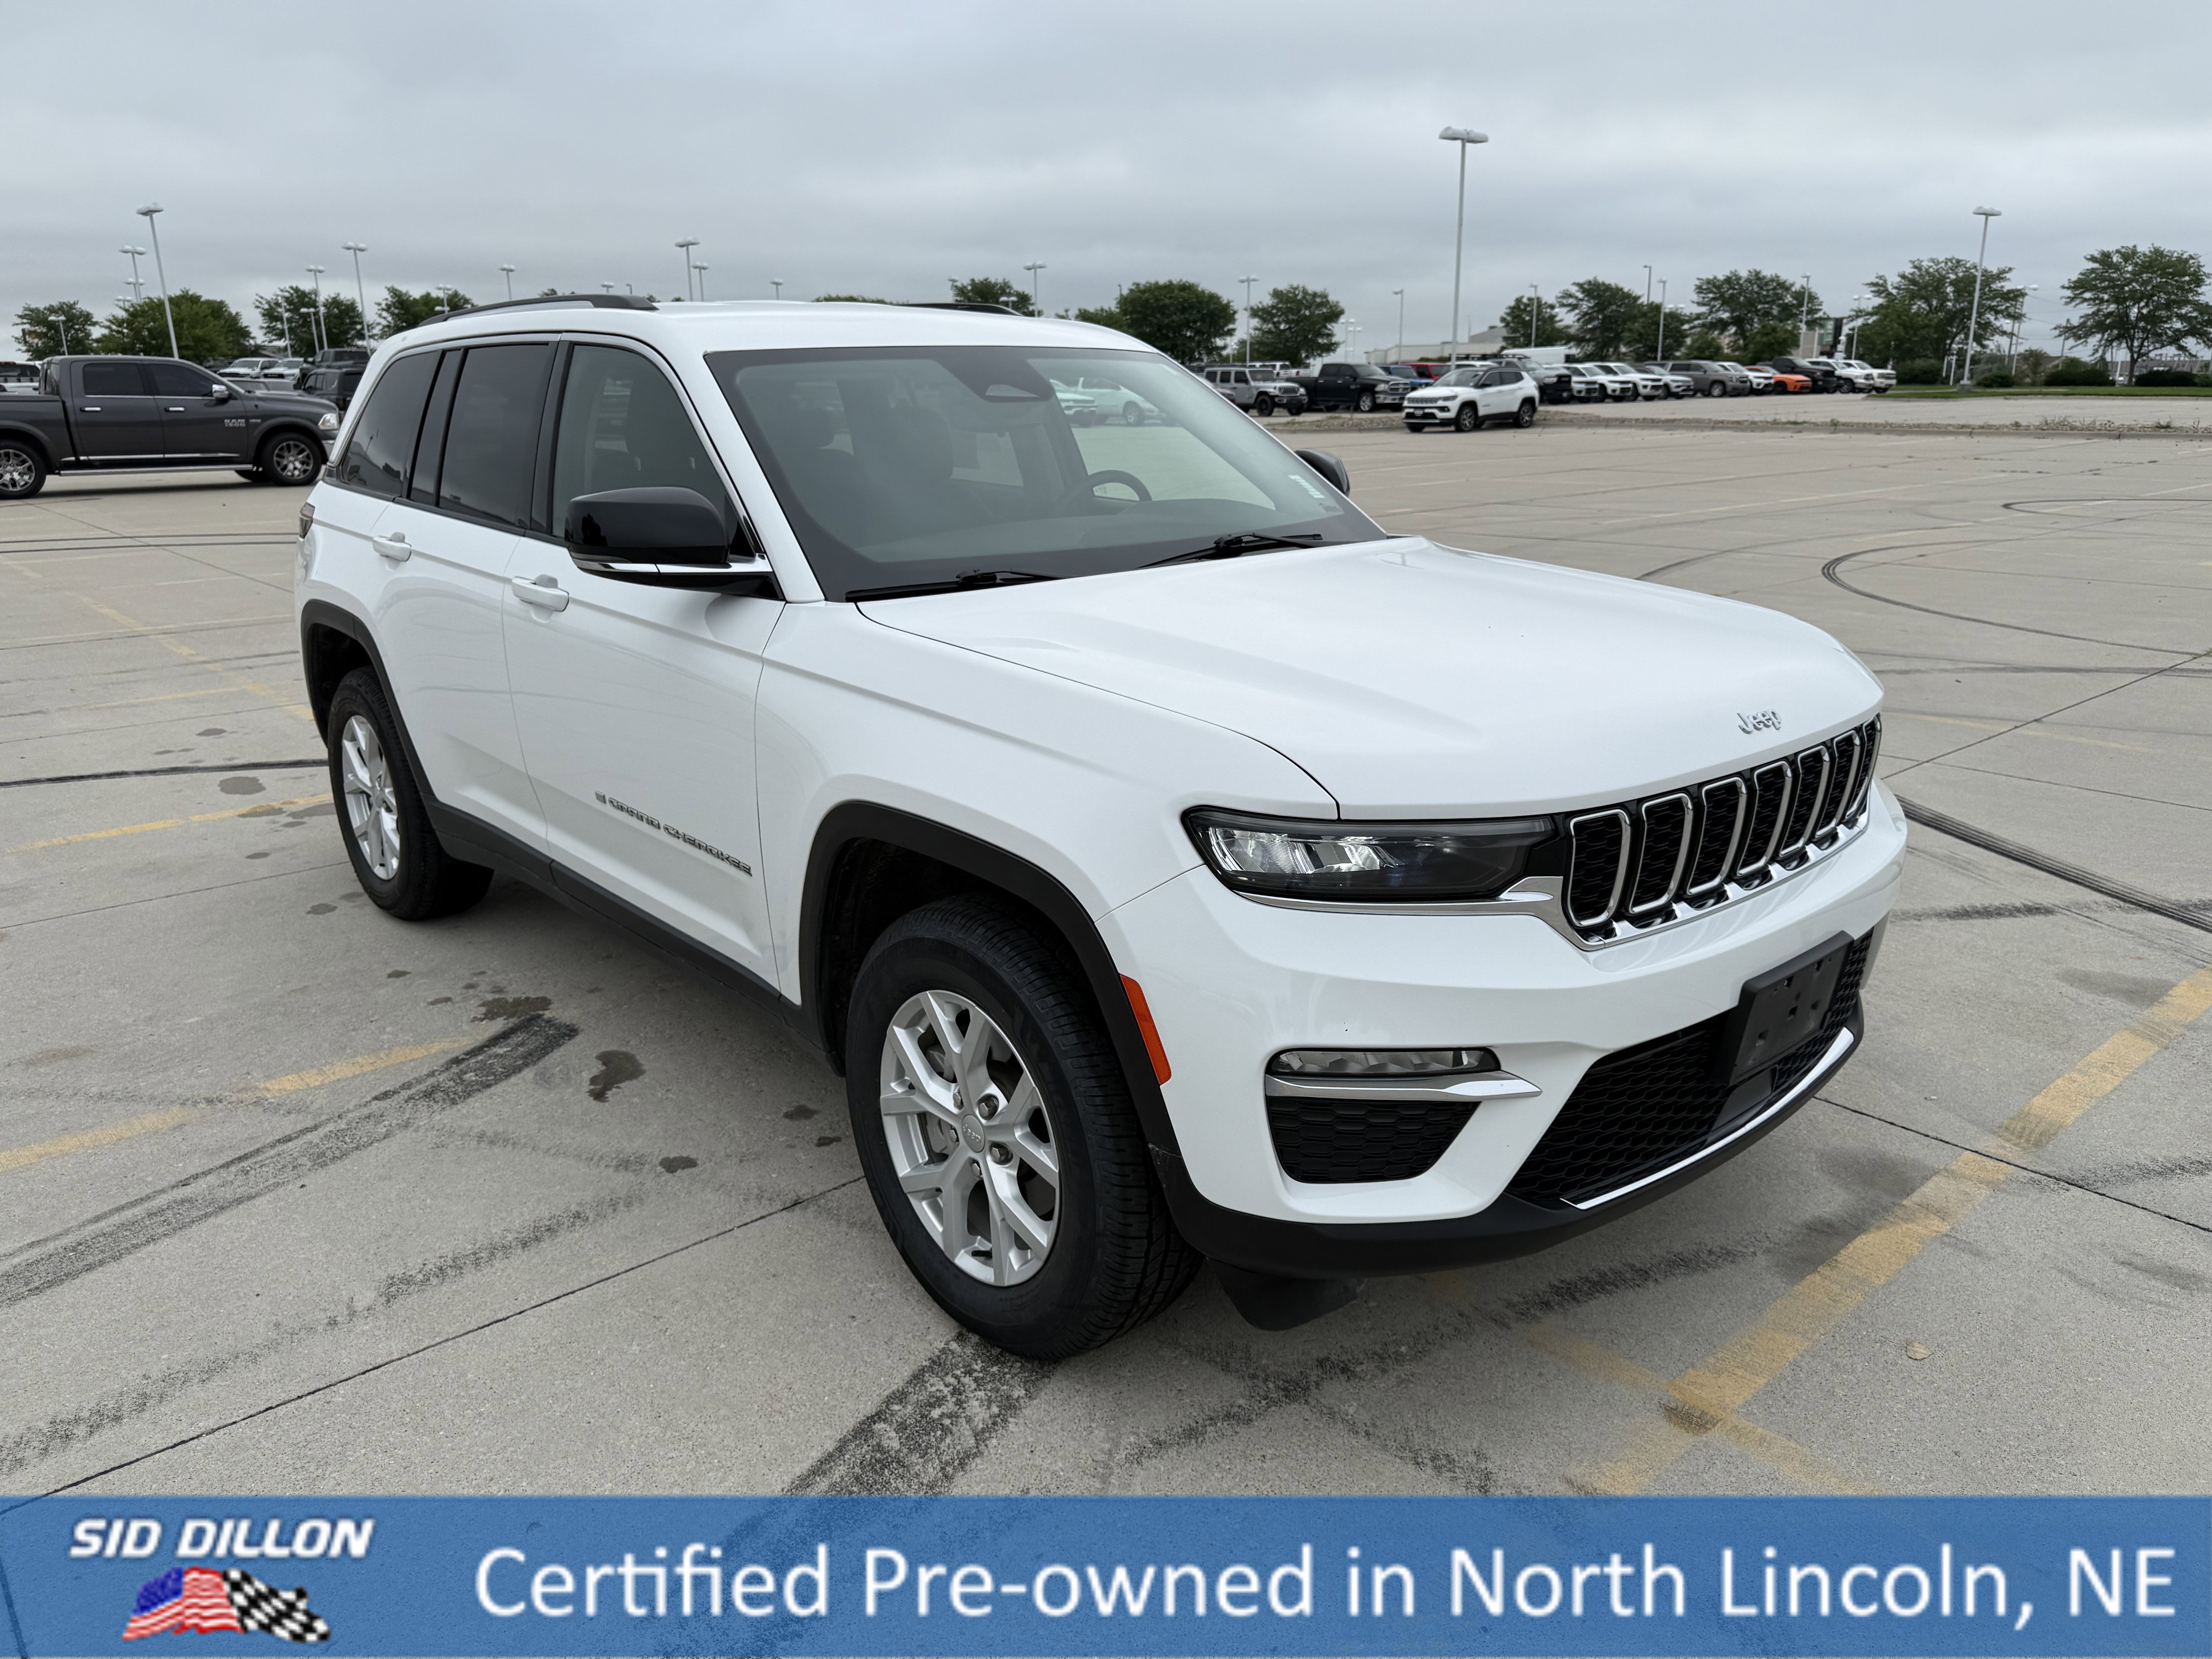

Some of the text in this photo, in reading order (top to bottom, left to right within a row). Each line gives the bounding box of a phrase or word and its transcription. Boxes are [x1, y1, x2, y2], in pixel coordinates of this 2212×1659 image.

[1737, 708, 1782, 734] Jeep
[608, 797, 752, 877] GRAND CHEROKEE
